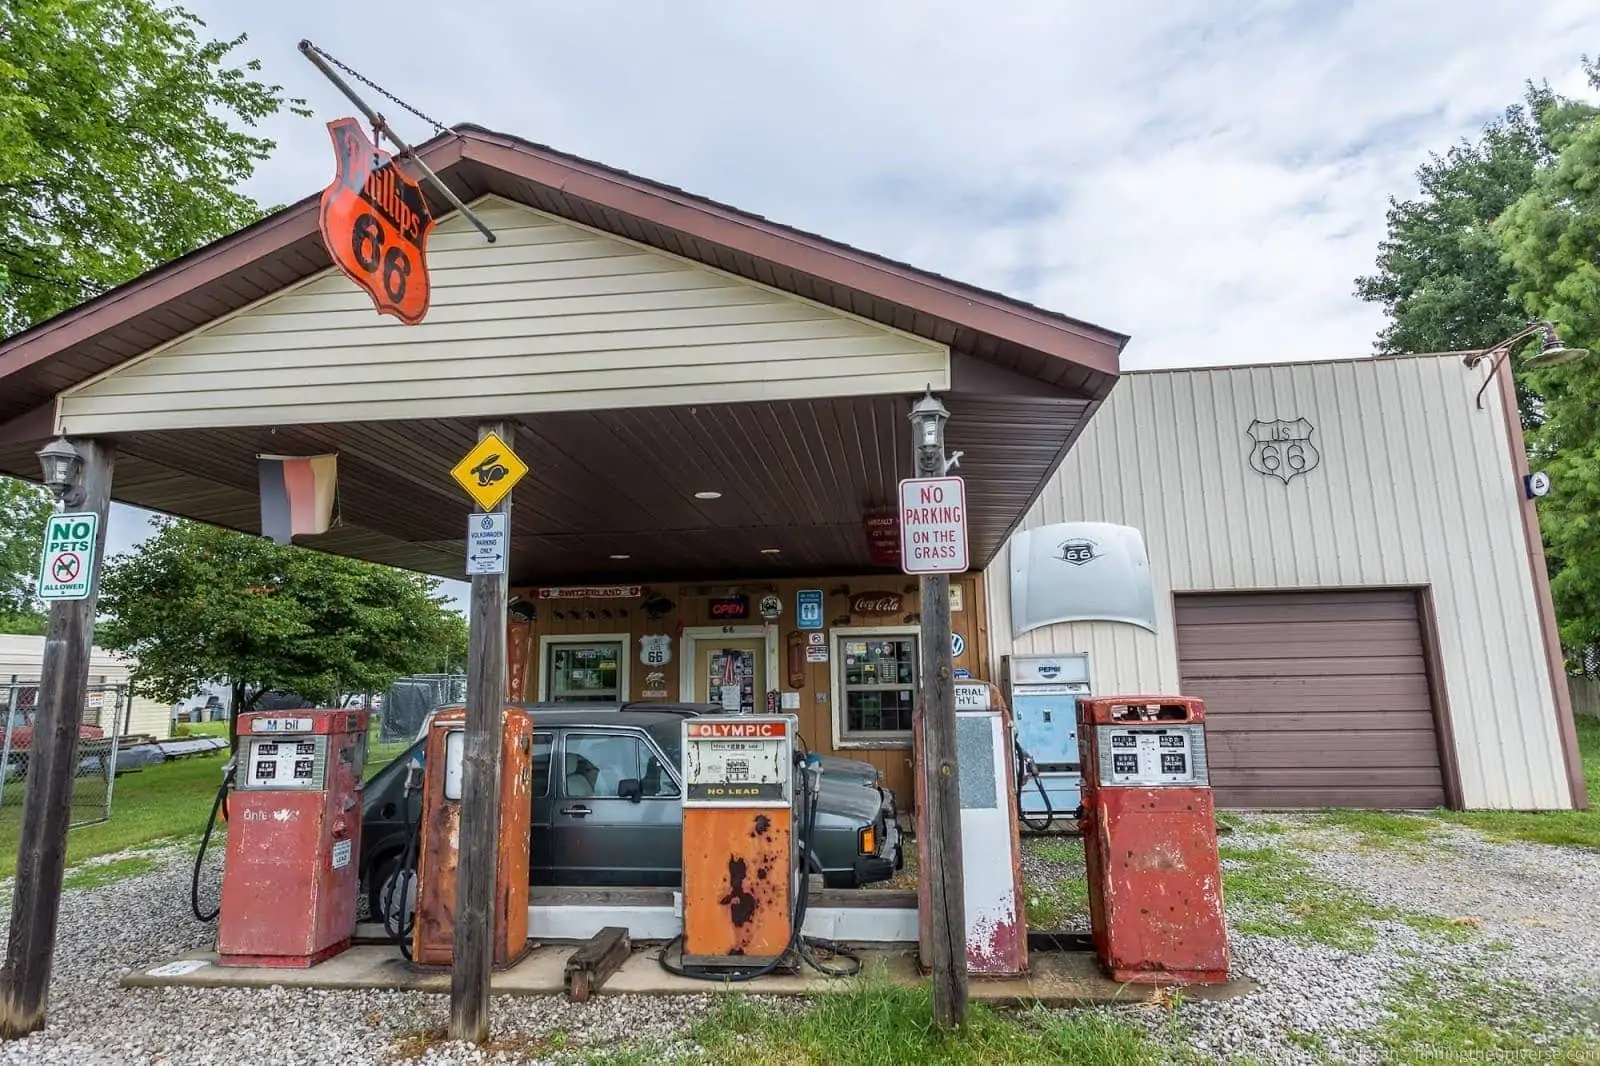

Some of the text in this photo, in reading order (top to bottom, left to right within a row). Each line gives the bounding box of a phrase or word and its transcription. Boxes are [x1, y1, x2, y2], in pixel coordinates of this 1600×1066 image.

[351, 213, 411, 304] 66
[1271, 426, 1290, 441] US
[1261, 444, 1306, 471] 66
[920, 487, 944, 505] NO
[906, 506, 961, 524] PARKING
[52, 522, 90, 541] NO
[913, 531, 929, 544] ON
[932, 530, 957, 543] THE
[50, 541, 89, 553] PETS
[476, 539, 498, 547] PARKING
[479, 547, 493, 555] ONLY
[914, 546, 957, 560] GRASS
[1066, 549, 1091, 560] 66
[44, 583, 85, 592] ALLOWED
[712, 603, 744, 615] OPEN
[854, 598, 899, 612] Coca-Cola
[722, 625, 735, 634] 66
[647, 651, 664, 663] 66
[954, 688, 985, 697] ERIAL
[957, 697, 979, 705] HYL
[266, 719, 299, 731] Mbil
[700, 724, 772, 737] OLYMPIC
